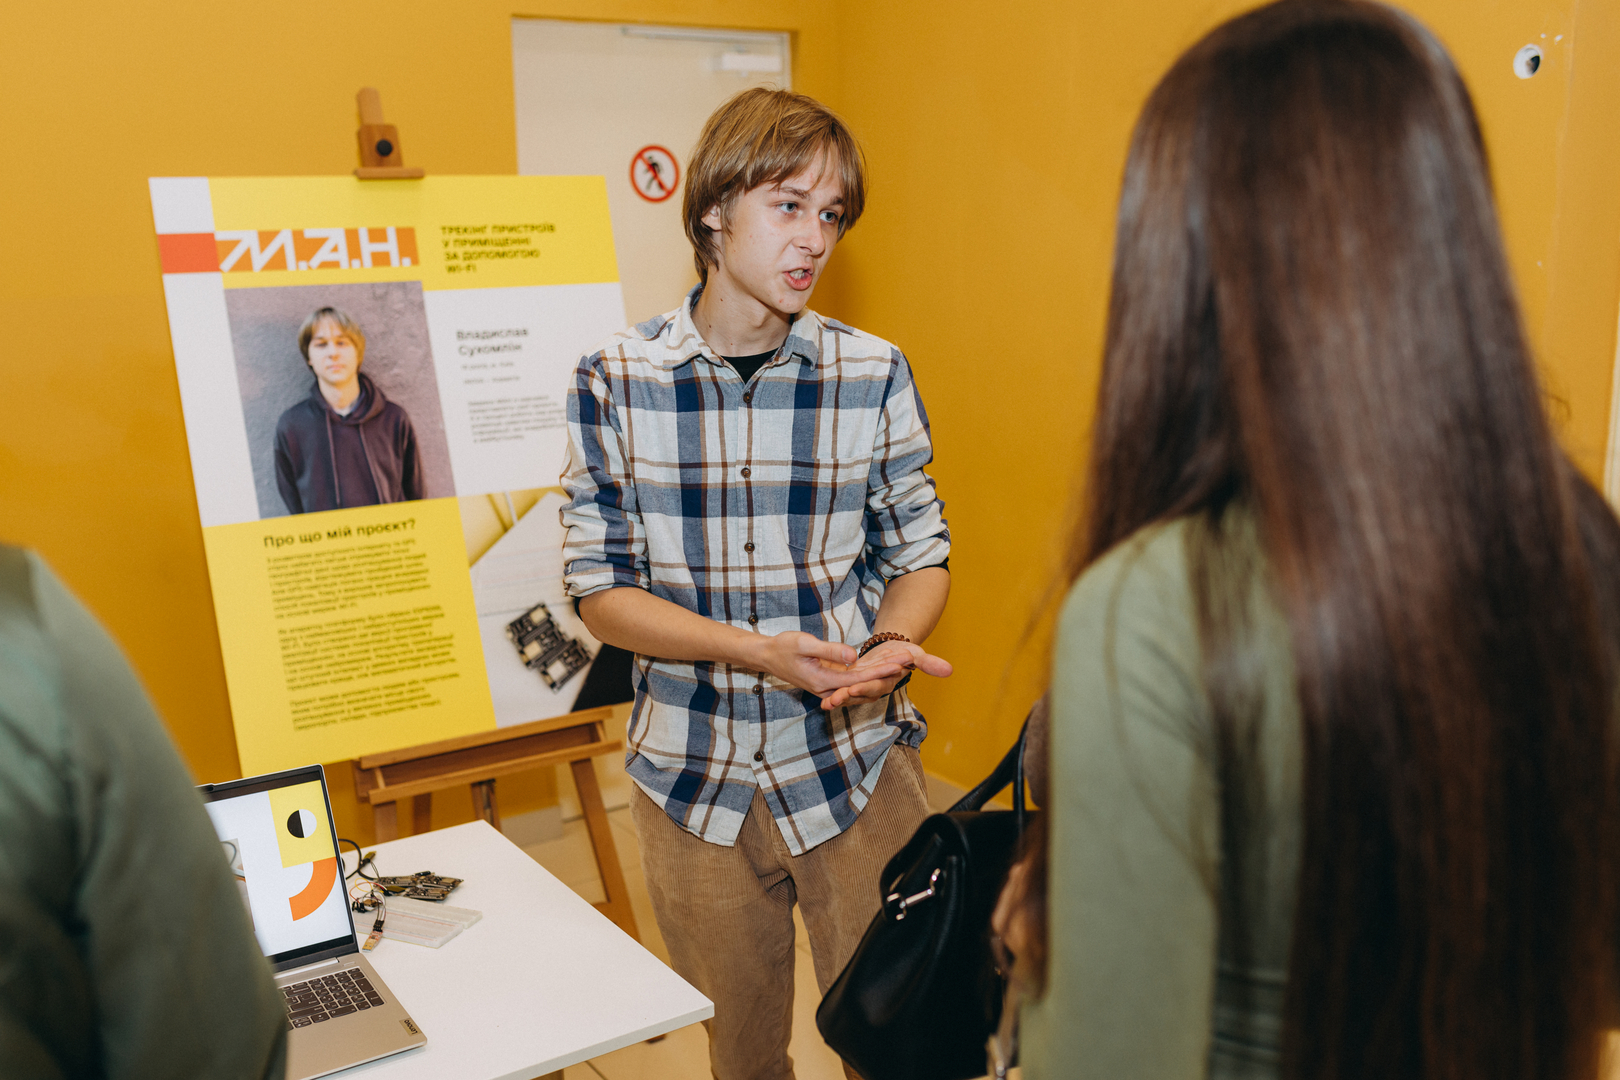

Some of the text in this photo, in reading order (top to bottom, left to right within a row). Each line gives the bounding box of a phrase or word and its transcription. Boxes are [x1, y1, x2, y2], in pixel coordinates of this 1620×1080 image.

[441, 222, 556, 235] ТРЕКІНГ ПРИСТРОЇВ
[442, 237, 530, 248] У ПРИМІЩЕННІ
[445, 248, 540, 261] ЗА ДОПОМОГОЮ
[456, 328, 528, 340] Владислав
[263, 517, 416, 548] Про що мій проєкт?
[403, 1019, 418, 1035] Lenovo
